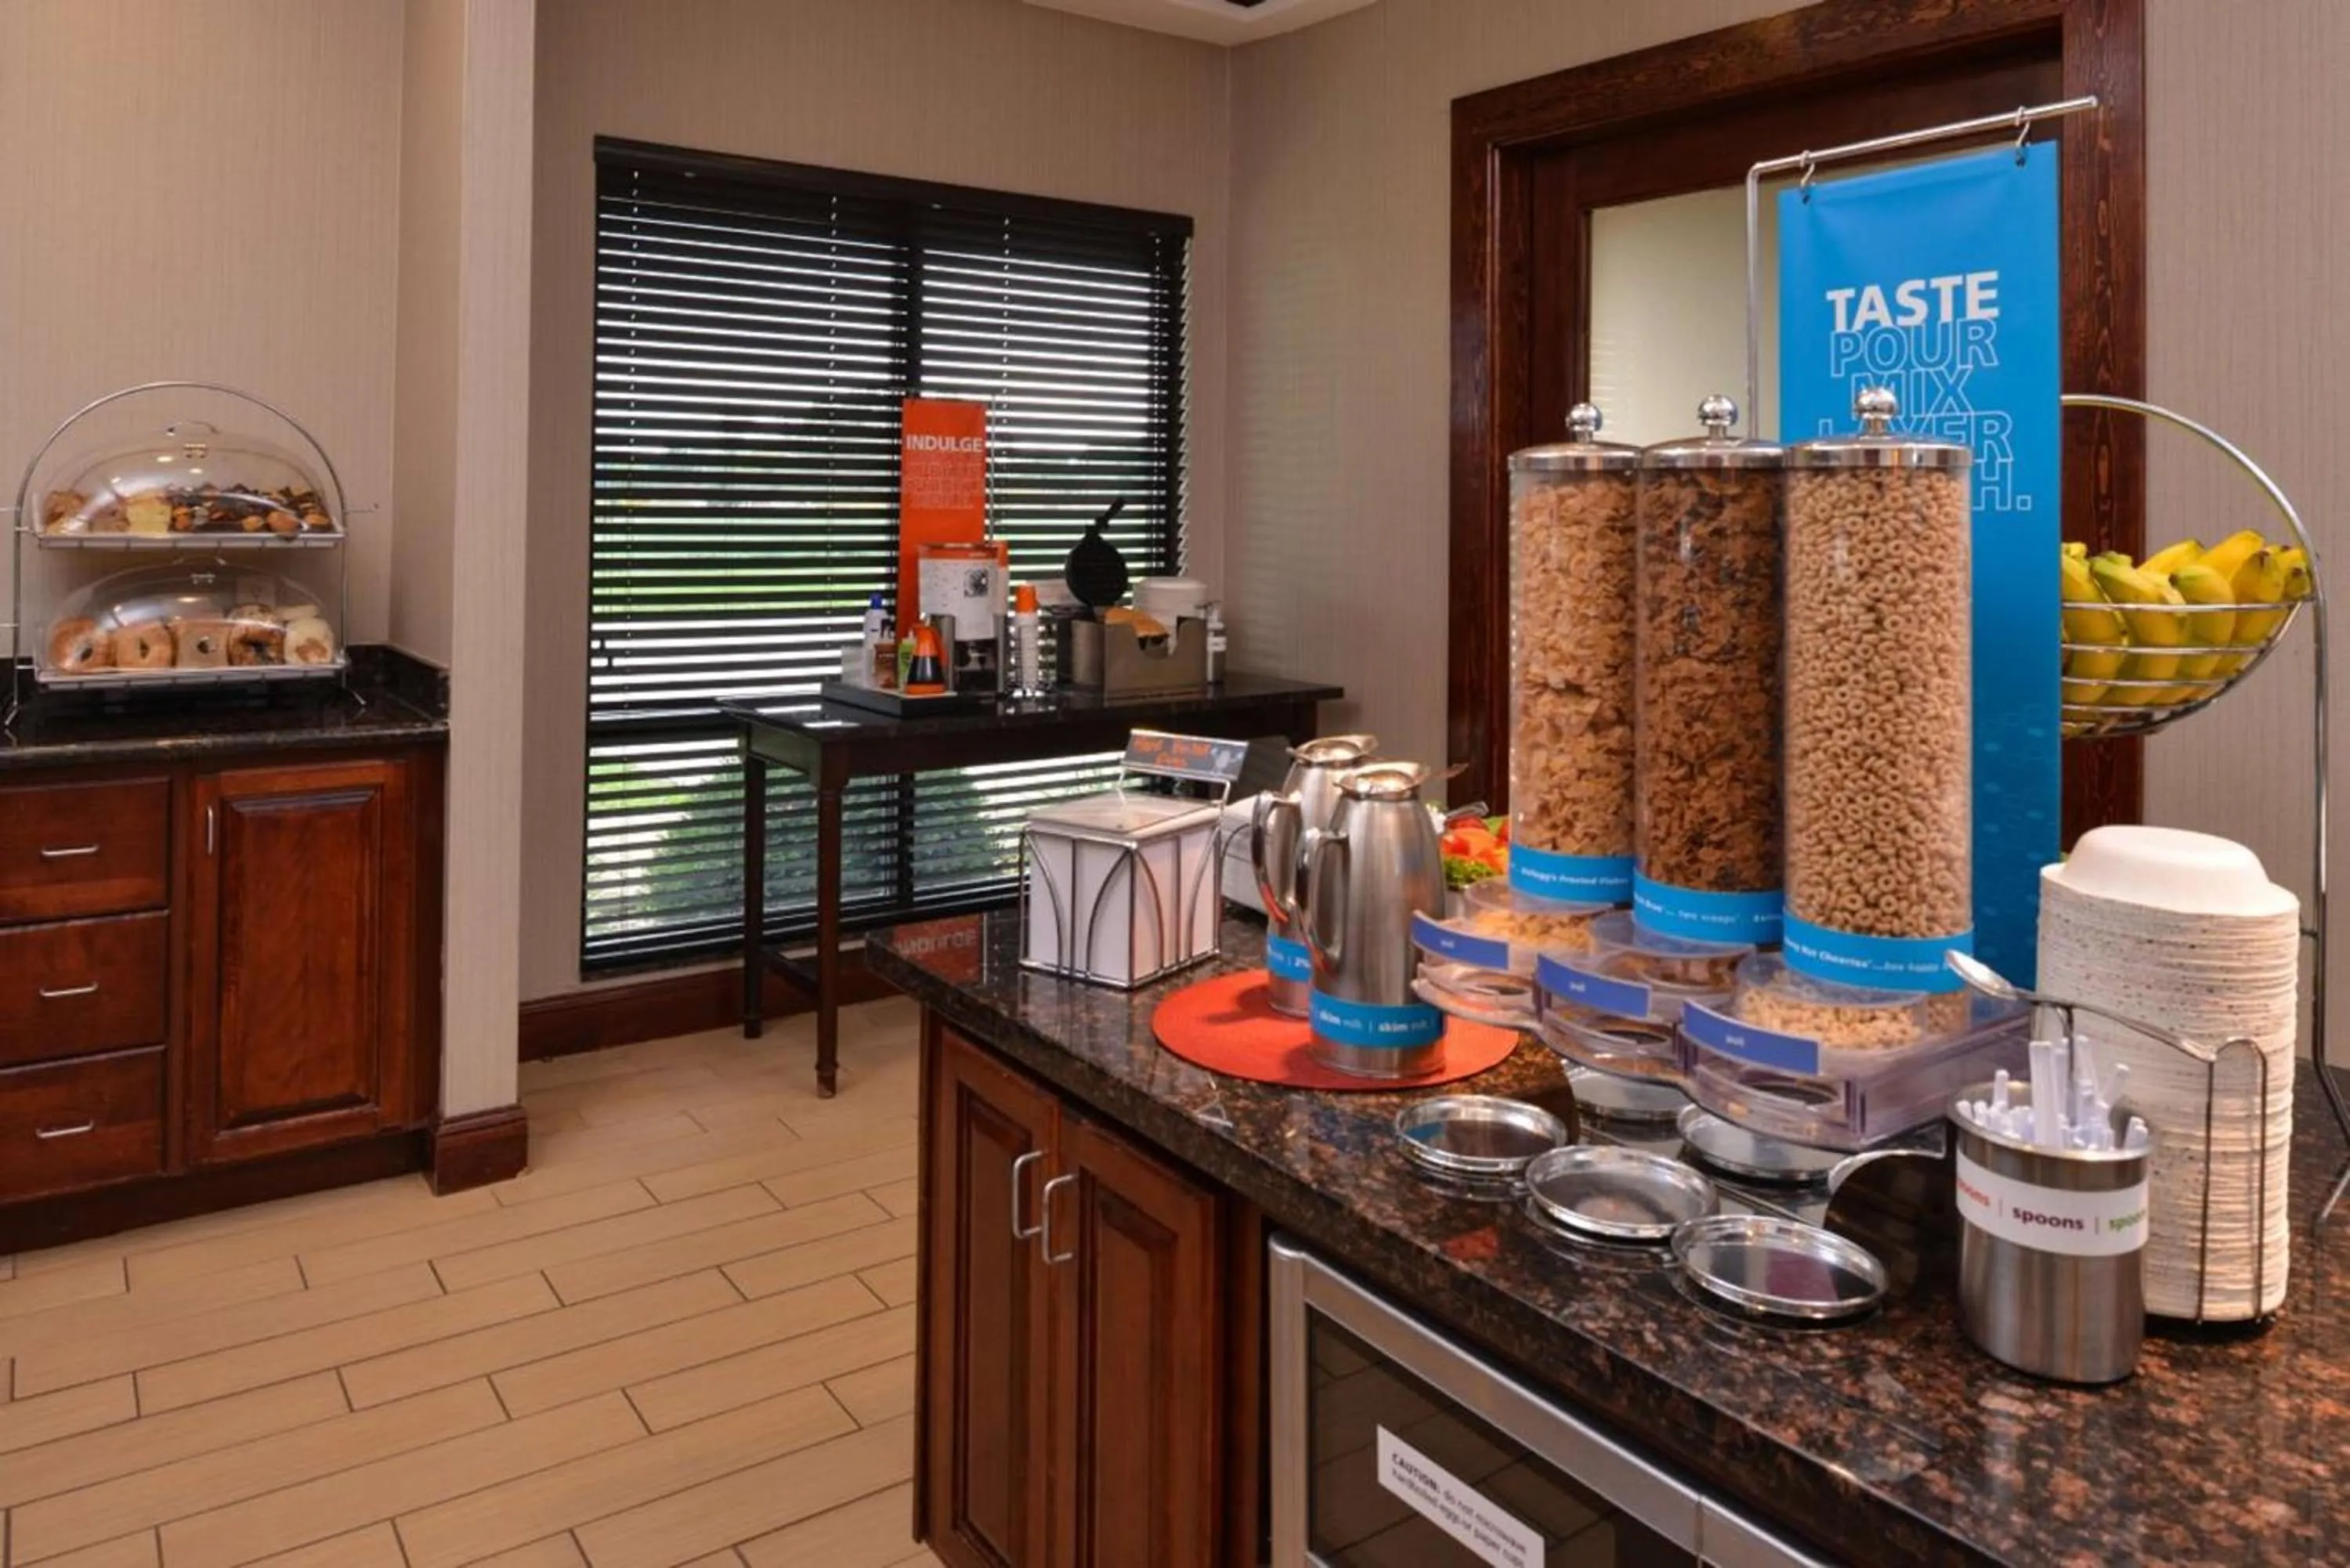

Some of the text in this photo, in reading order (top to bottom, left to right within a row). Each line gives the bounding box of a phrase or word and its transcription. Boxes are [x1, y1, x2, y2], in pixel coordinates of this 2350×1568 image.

[1826, 270, 2000, 333] TASTE
[1830, 318, 1999, 378] POUR
[906, 434, 983, 453] INDULGE
[2012, 1206, 2085, 1230] spoons
